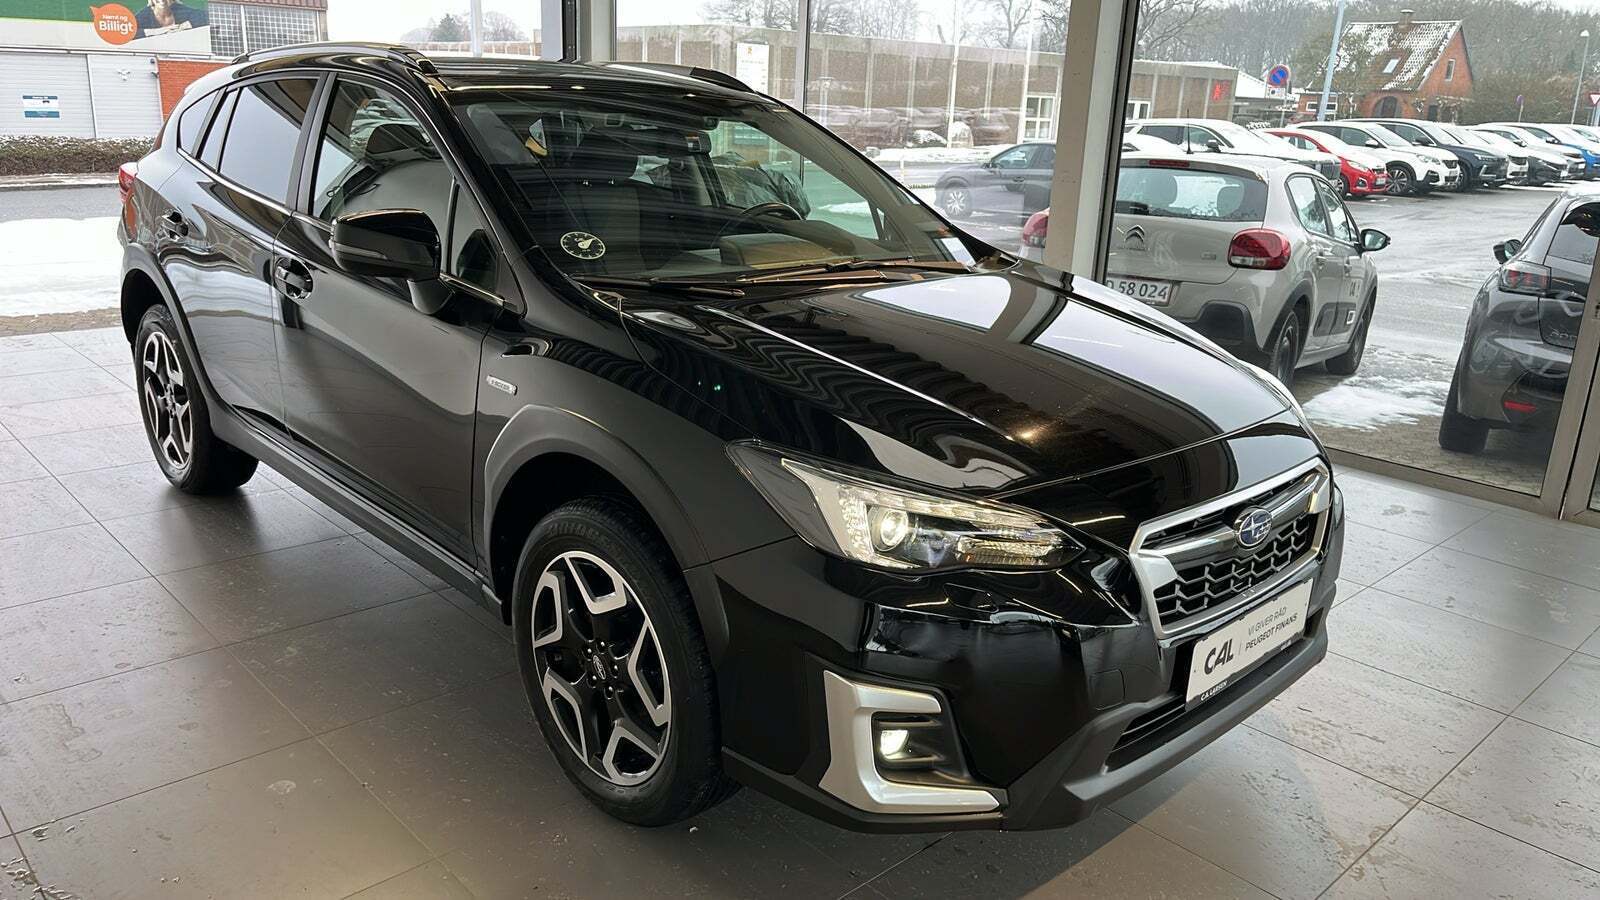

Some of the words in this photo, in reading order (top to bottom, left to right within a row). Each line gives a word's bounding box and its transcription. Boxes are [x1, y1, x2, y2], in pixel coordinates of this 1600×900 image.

[99, 20, 134, 35] Billigt
[1119, 281, 1136, 296] 58
[1139, 283, 1168, 299] 024
[1245, 626, 1276, 651] PEUGEOT
[1275, 612, 1298, 632] FINANS
[1248, 624, 1256, 637] VI
[1256, 614, 1274, 632] GIVER
[1274, 606, 1287, 621] RÅD
[1204, 638, 1234, 675] CAL
[1209, 680, 1228, 696] LARSEN
